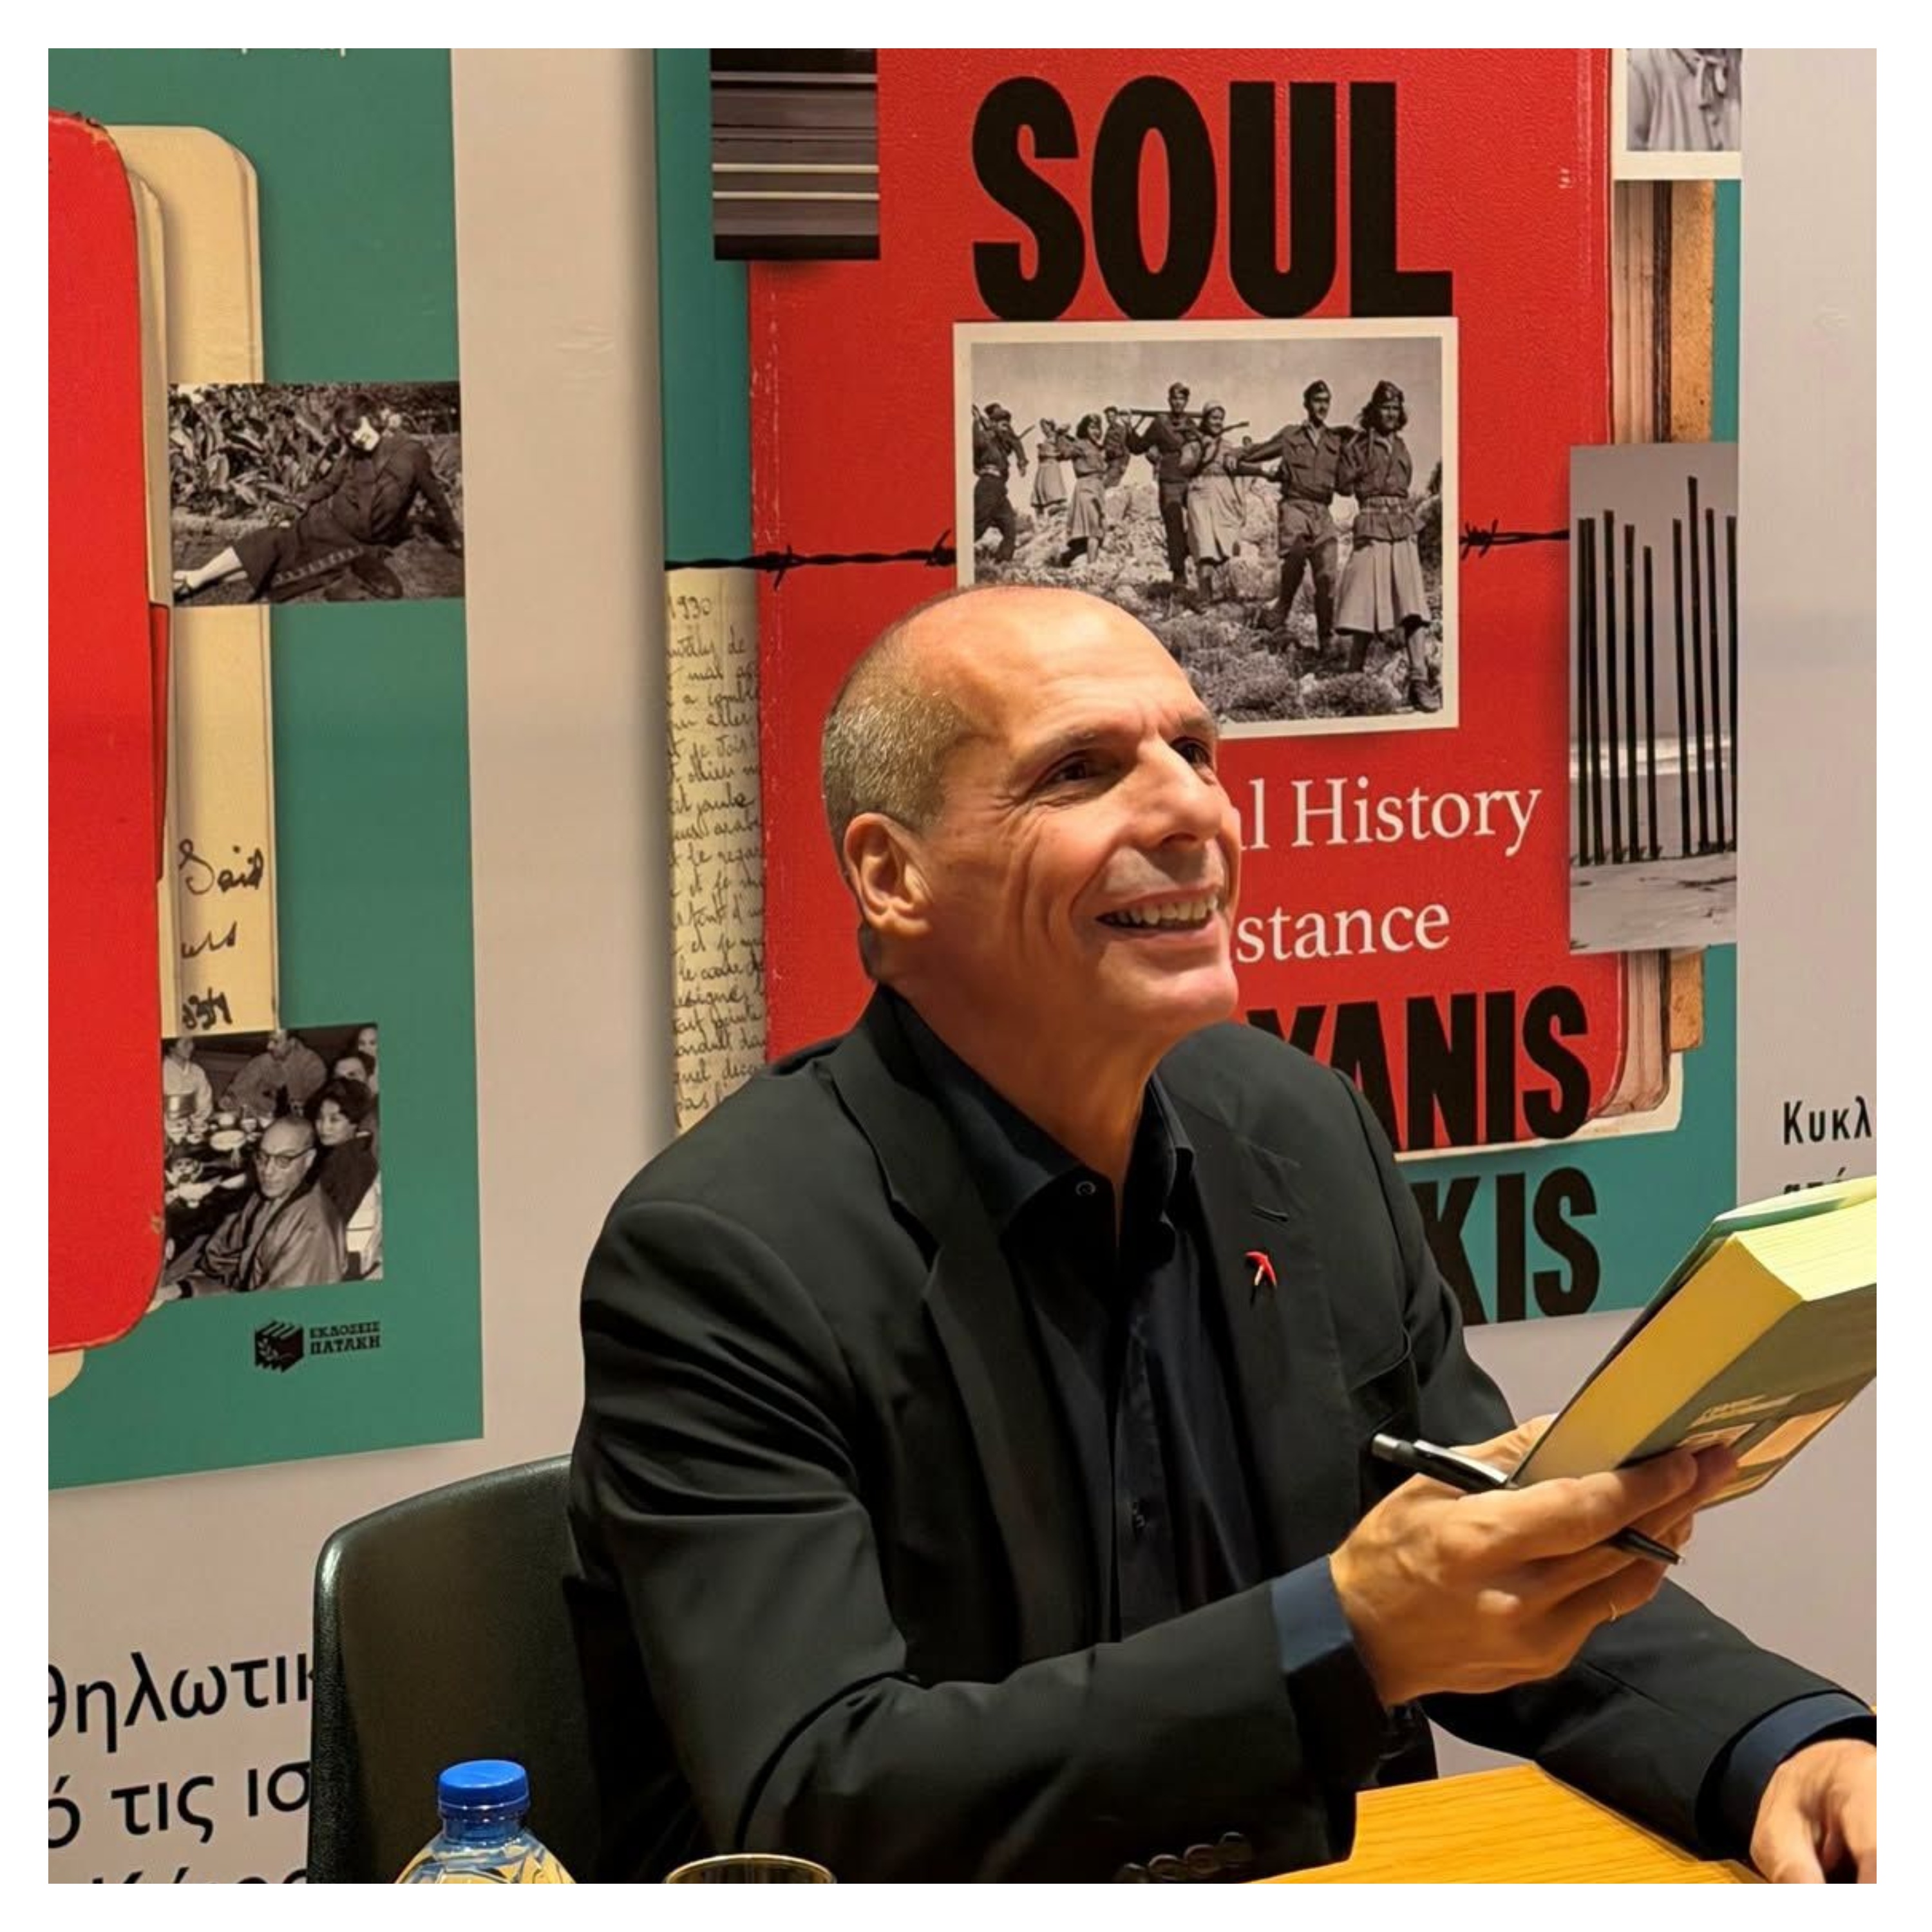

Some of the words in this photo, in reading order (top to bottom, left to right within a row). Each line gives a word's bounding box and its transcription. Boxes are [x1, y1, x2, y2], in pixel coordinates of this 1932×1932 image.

[972, 75, 1453, 321] SOUL
[1240, 778, 1270, 852] l
[1291, 776, 1542, 857] History
[1236, 904, 1450, 963] stance
[1783, 1095, 1872, 1145] Κυκλ
[310, 1321, 380, 1339] ΕΚΔΟΣΕΙΣ
[310, 1336, 381, 1356] ΠΑΤΑΚΗ
[111, 1776, 214, 1844] τις
